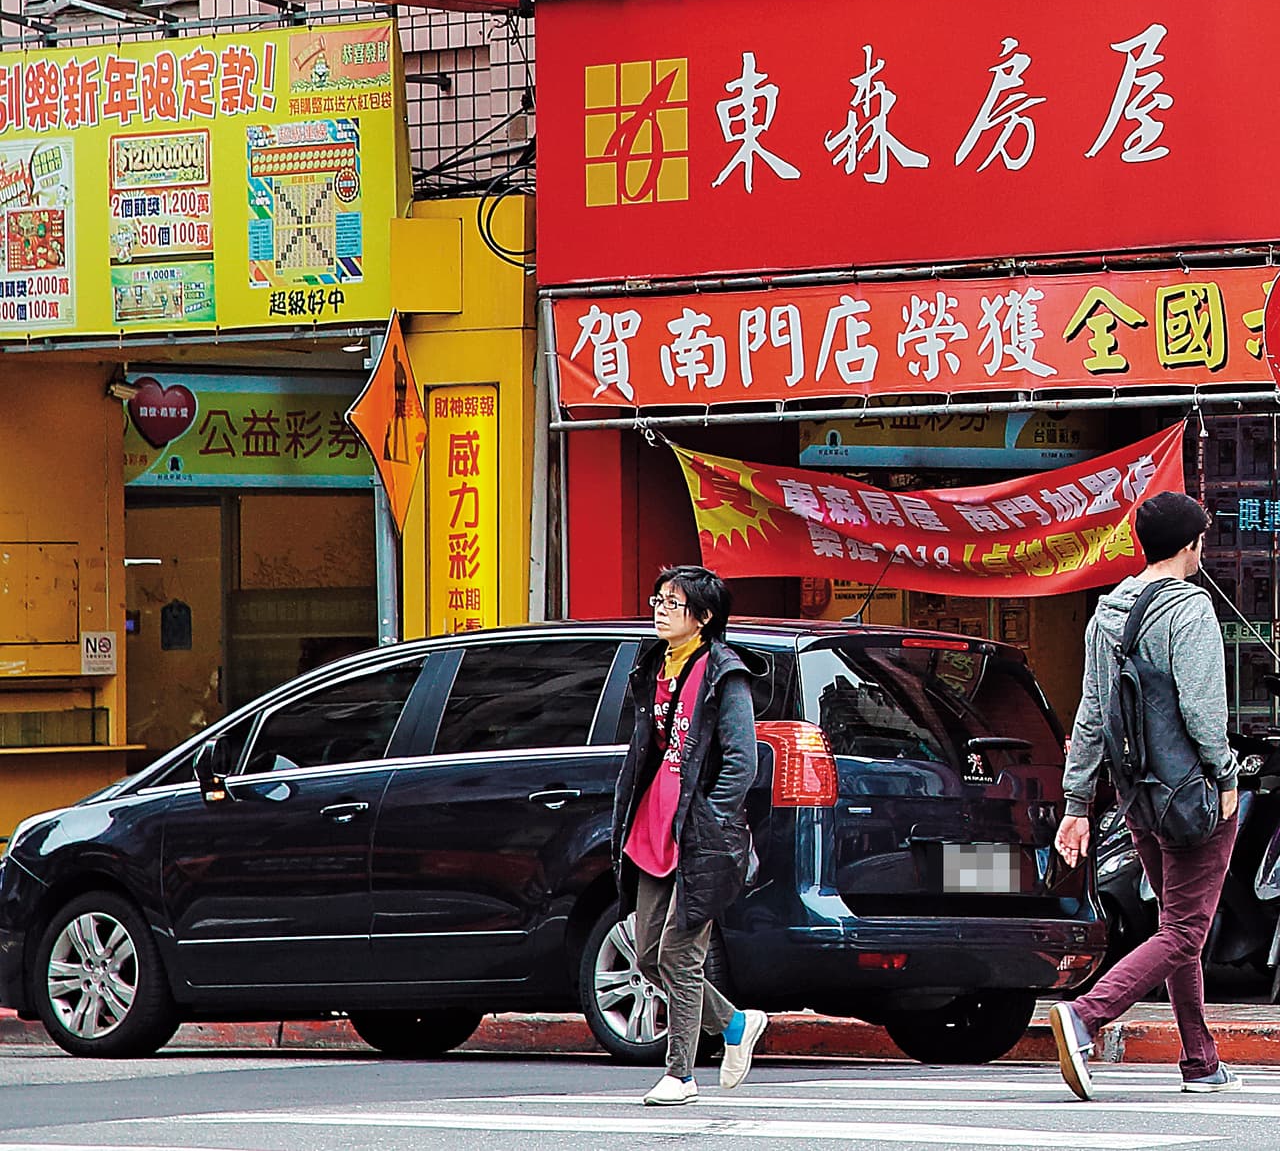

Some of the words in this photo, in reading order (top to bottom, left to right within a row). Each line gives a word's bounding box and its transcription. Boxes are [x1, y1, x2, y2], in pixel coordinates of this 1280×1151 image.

[711, 23, 1175, 194] 東森房屋
[269, 287, 345, 316] 超級好中
[434, 396, 494, 419] 財神報報
[199, 409, 362, 460] 公益彩券
[448, 430, 480, 580] 威力彩
[448, 588, 480, 611] 本期
